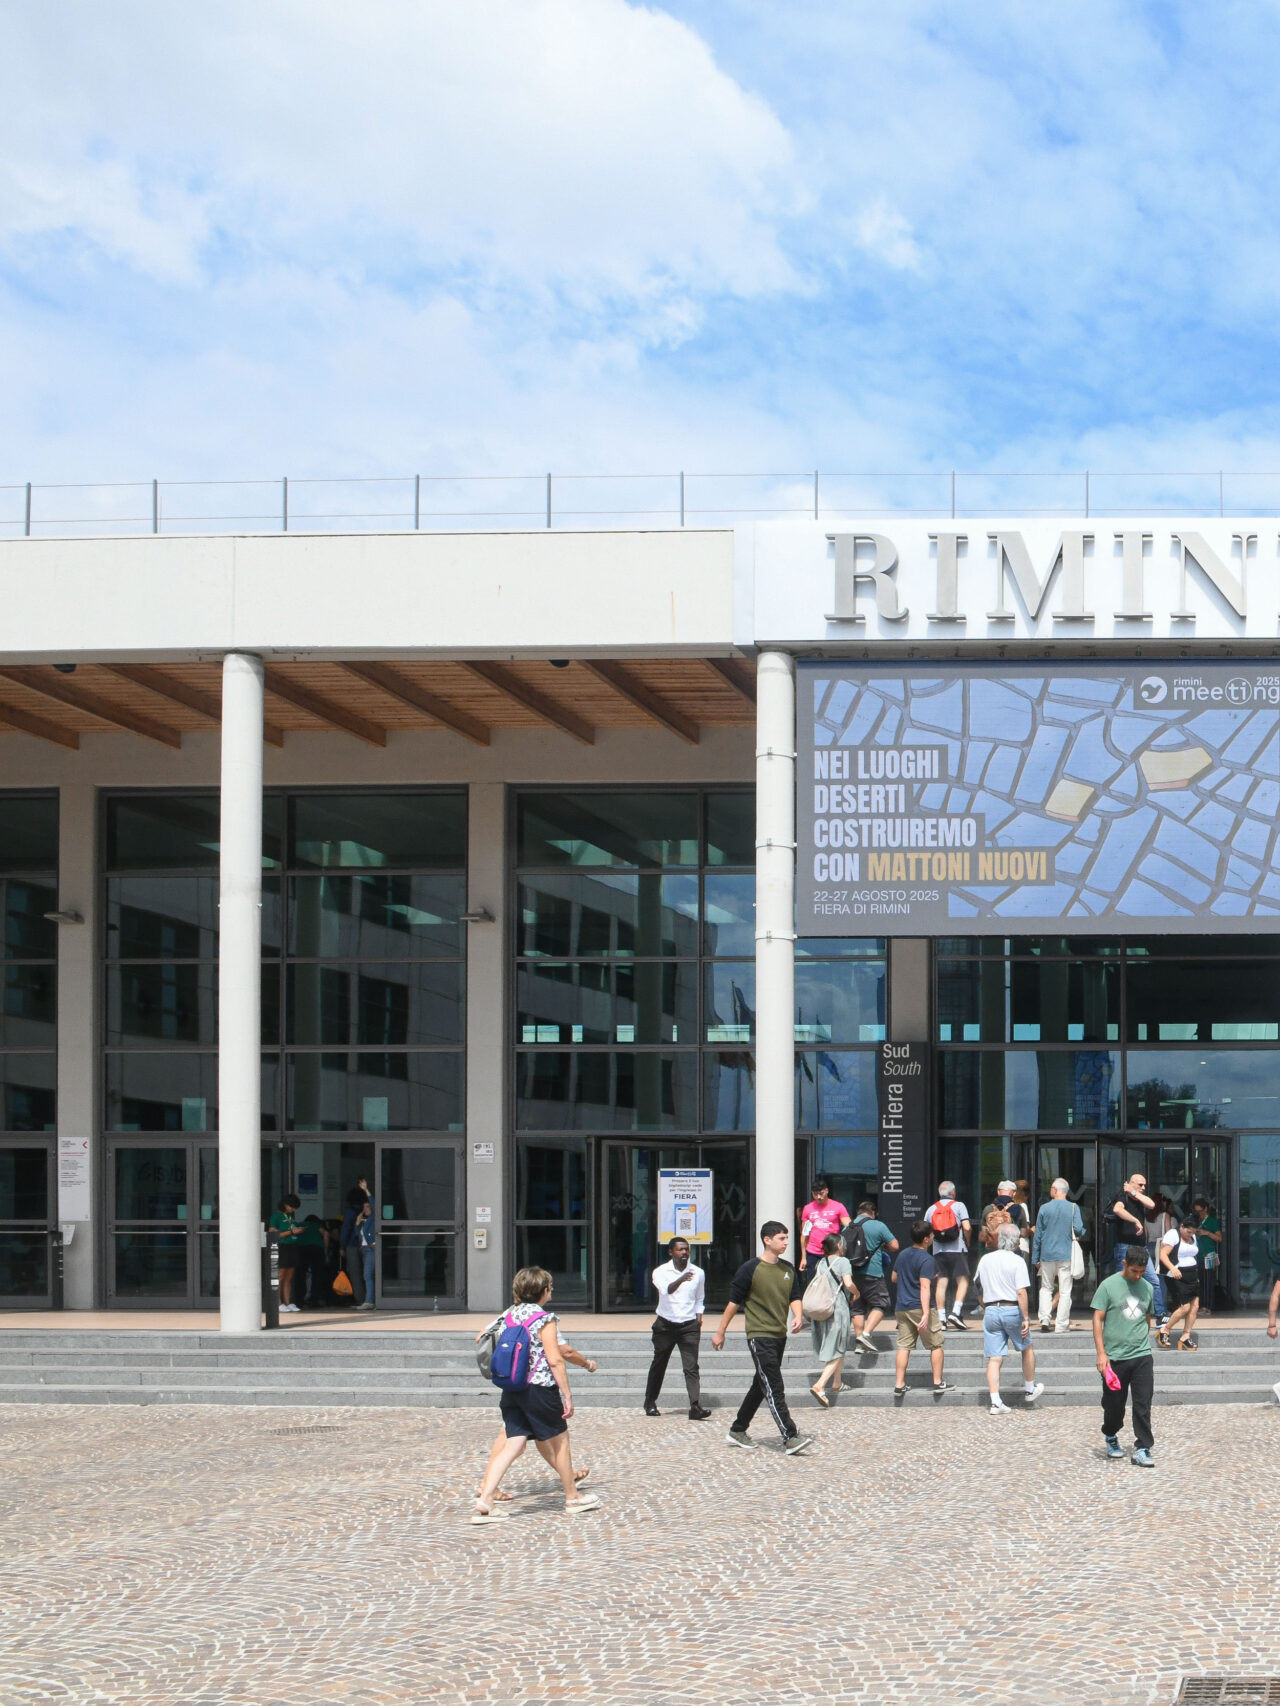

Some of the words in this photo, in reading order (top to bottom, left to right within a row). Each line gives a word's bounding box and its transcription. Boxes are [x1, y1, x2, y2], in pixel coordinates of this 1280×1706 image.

[1173, 680, 1280, 705] meeting
[1174, 677, 1202, 686] rimini
[1256, 677, 1280, 686] 2025
[814, 750, 850, 779] NEI
[858, 750, 939, 779] LUOGHI
[814, 784, 905, 813] DESERTI
[814, 818, 976, 847] COSTRUIREMO
[814, 853, 860, 882] CON
[868, 852, 970, 881] MATTONI
[978, 851, 1047, 881] NUOVI
[813, 891, 848, 902] 22-27
[851, 890, 907, 901] AGOSTO
[910, 890, 940, 901] 2025
[814, 904, 851, 915] FIERA
[854, 903, 866, 914] DI
[870, 903, 910, 914] RIMINI
[883, 1043, 910, 1058] Sud
[883, 1061, 921, 1076] South
[883, 1084, 903, 1129] Fiera
[883, 1134, 903, 1193] Rimini
